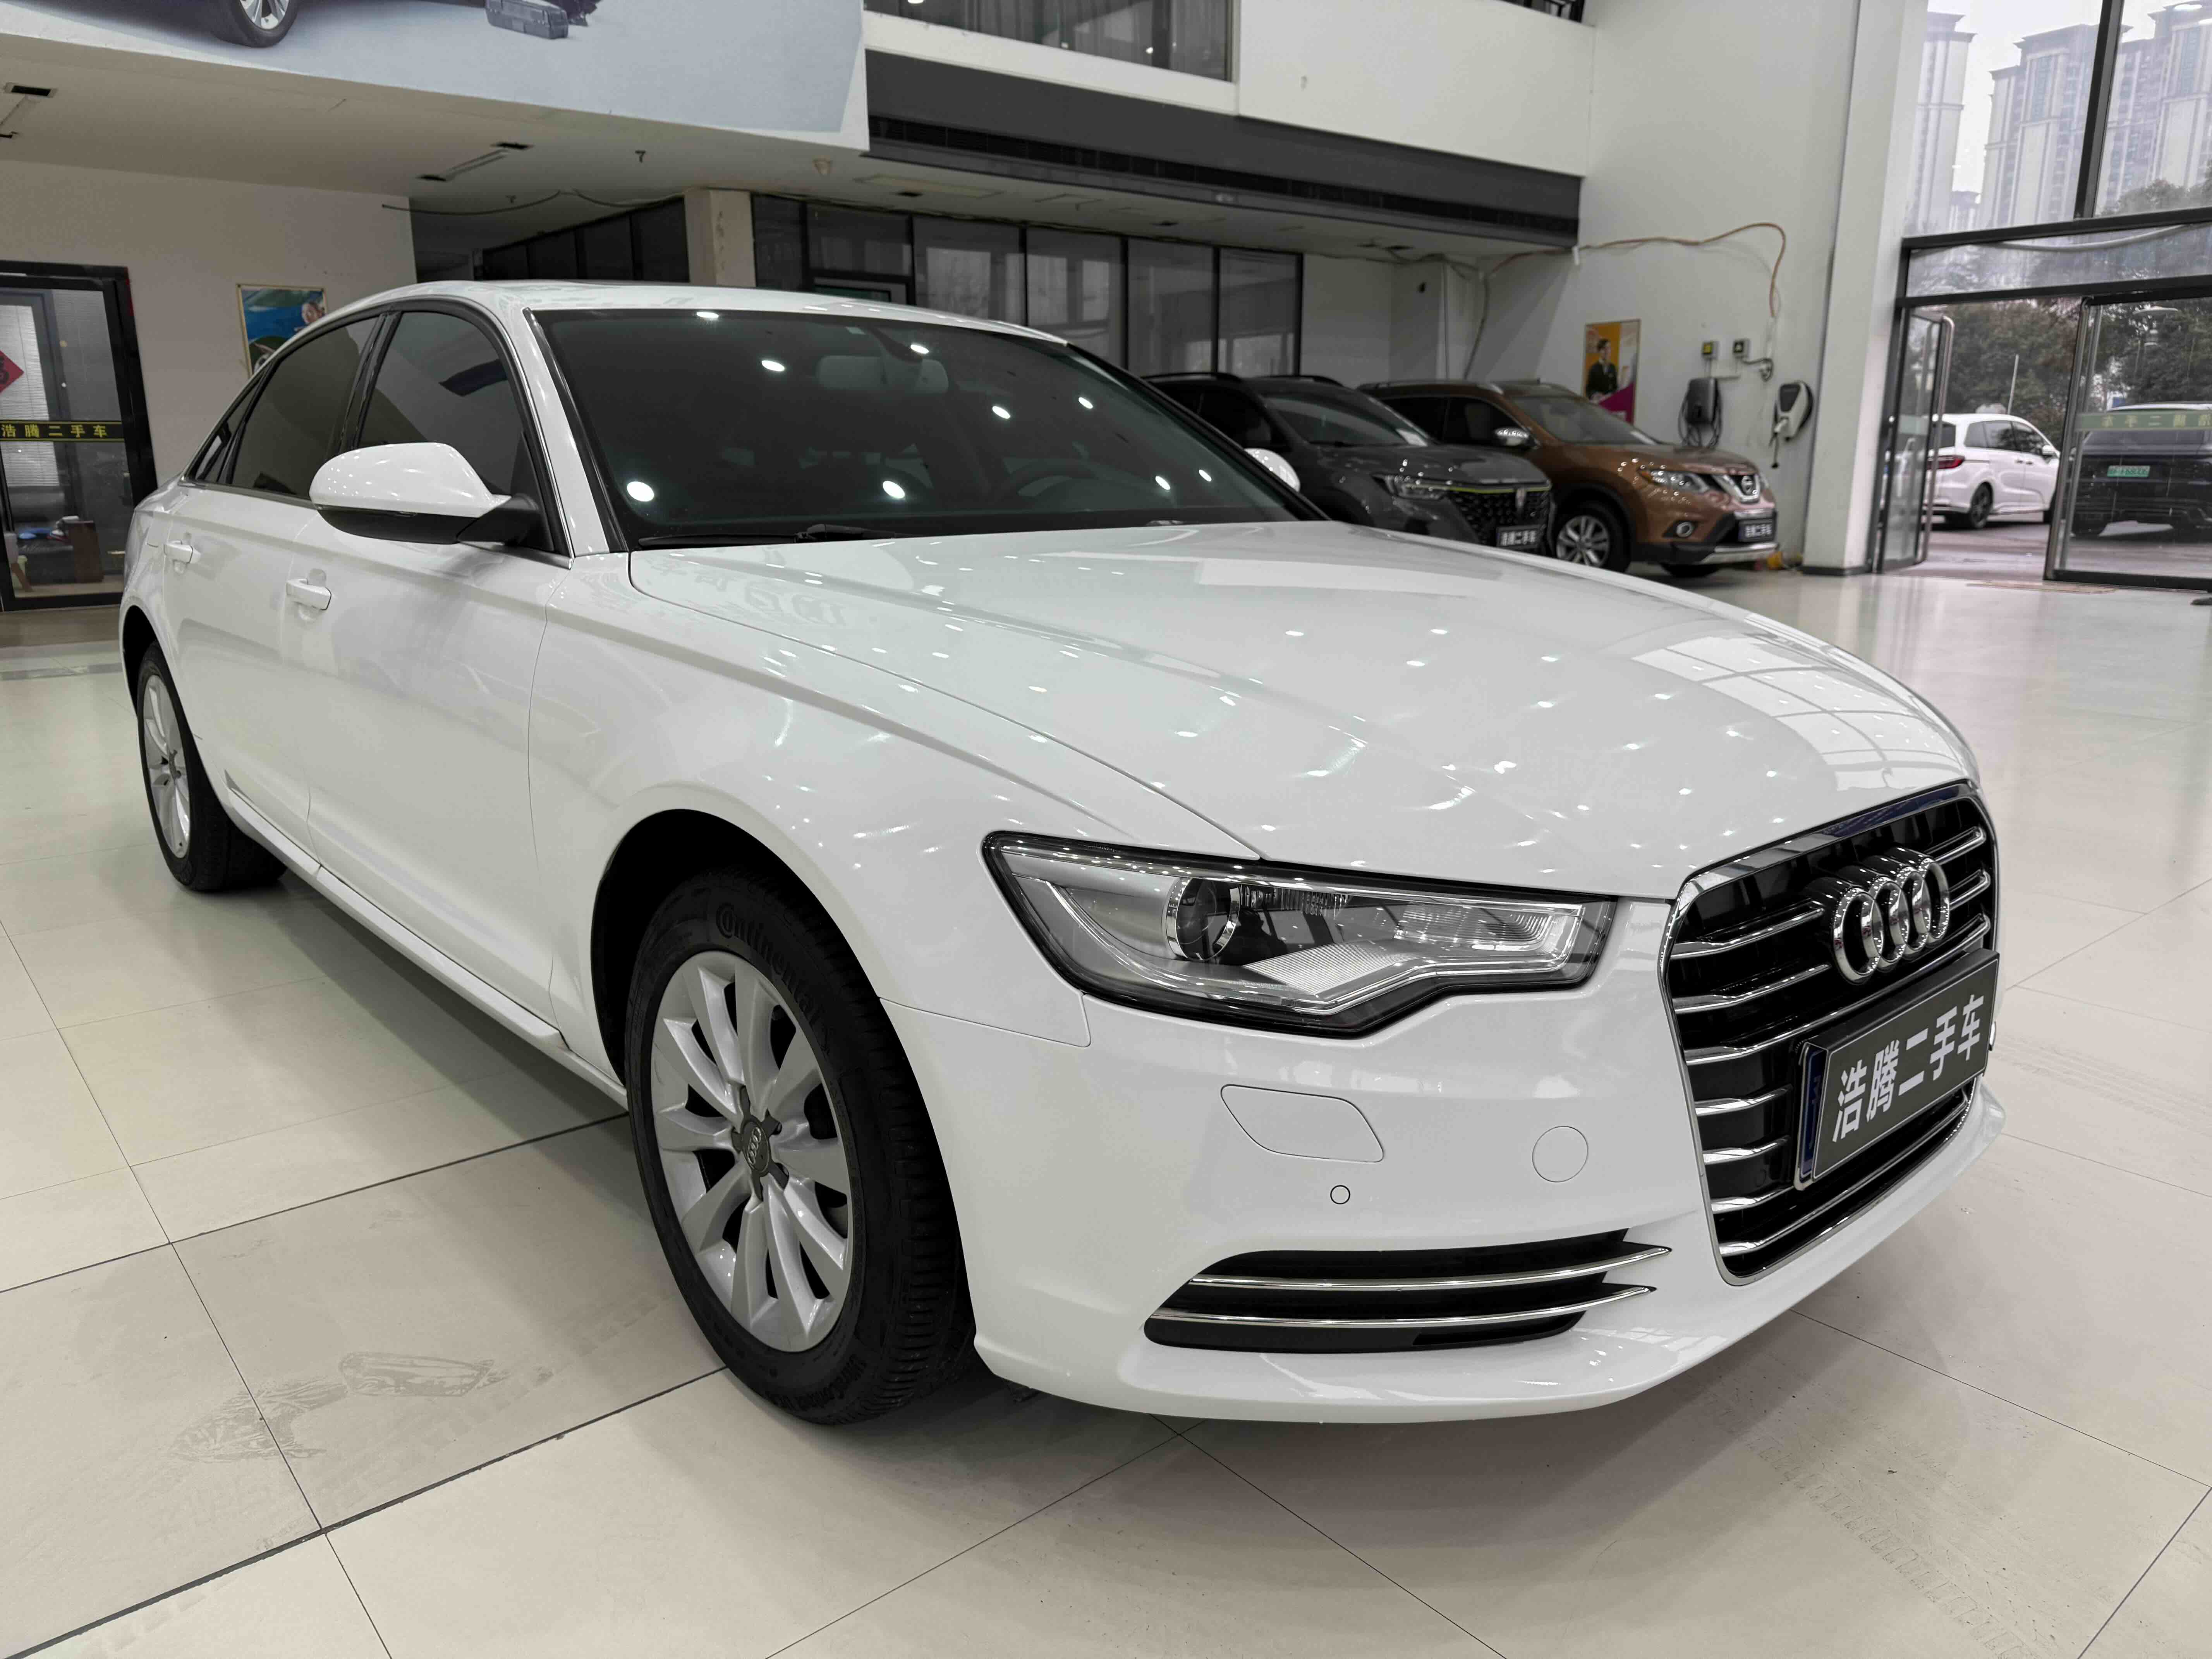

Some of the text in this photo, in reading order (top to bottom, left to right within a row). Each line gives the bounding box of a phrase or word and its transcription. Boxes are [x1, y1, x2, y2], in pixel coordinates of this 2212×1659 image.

[1, 424, 108, 439] 浩腾二手车
[1832, 994, 1984, 1142] 浩腾二手车
